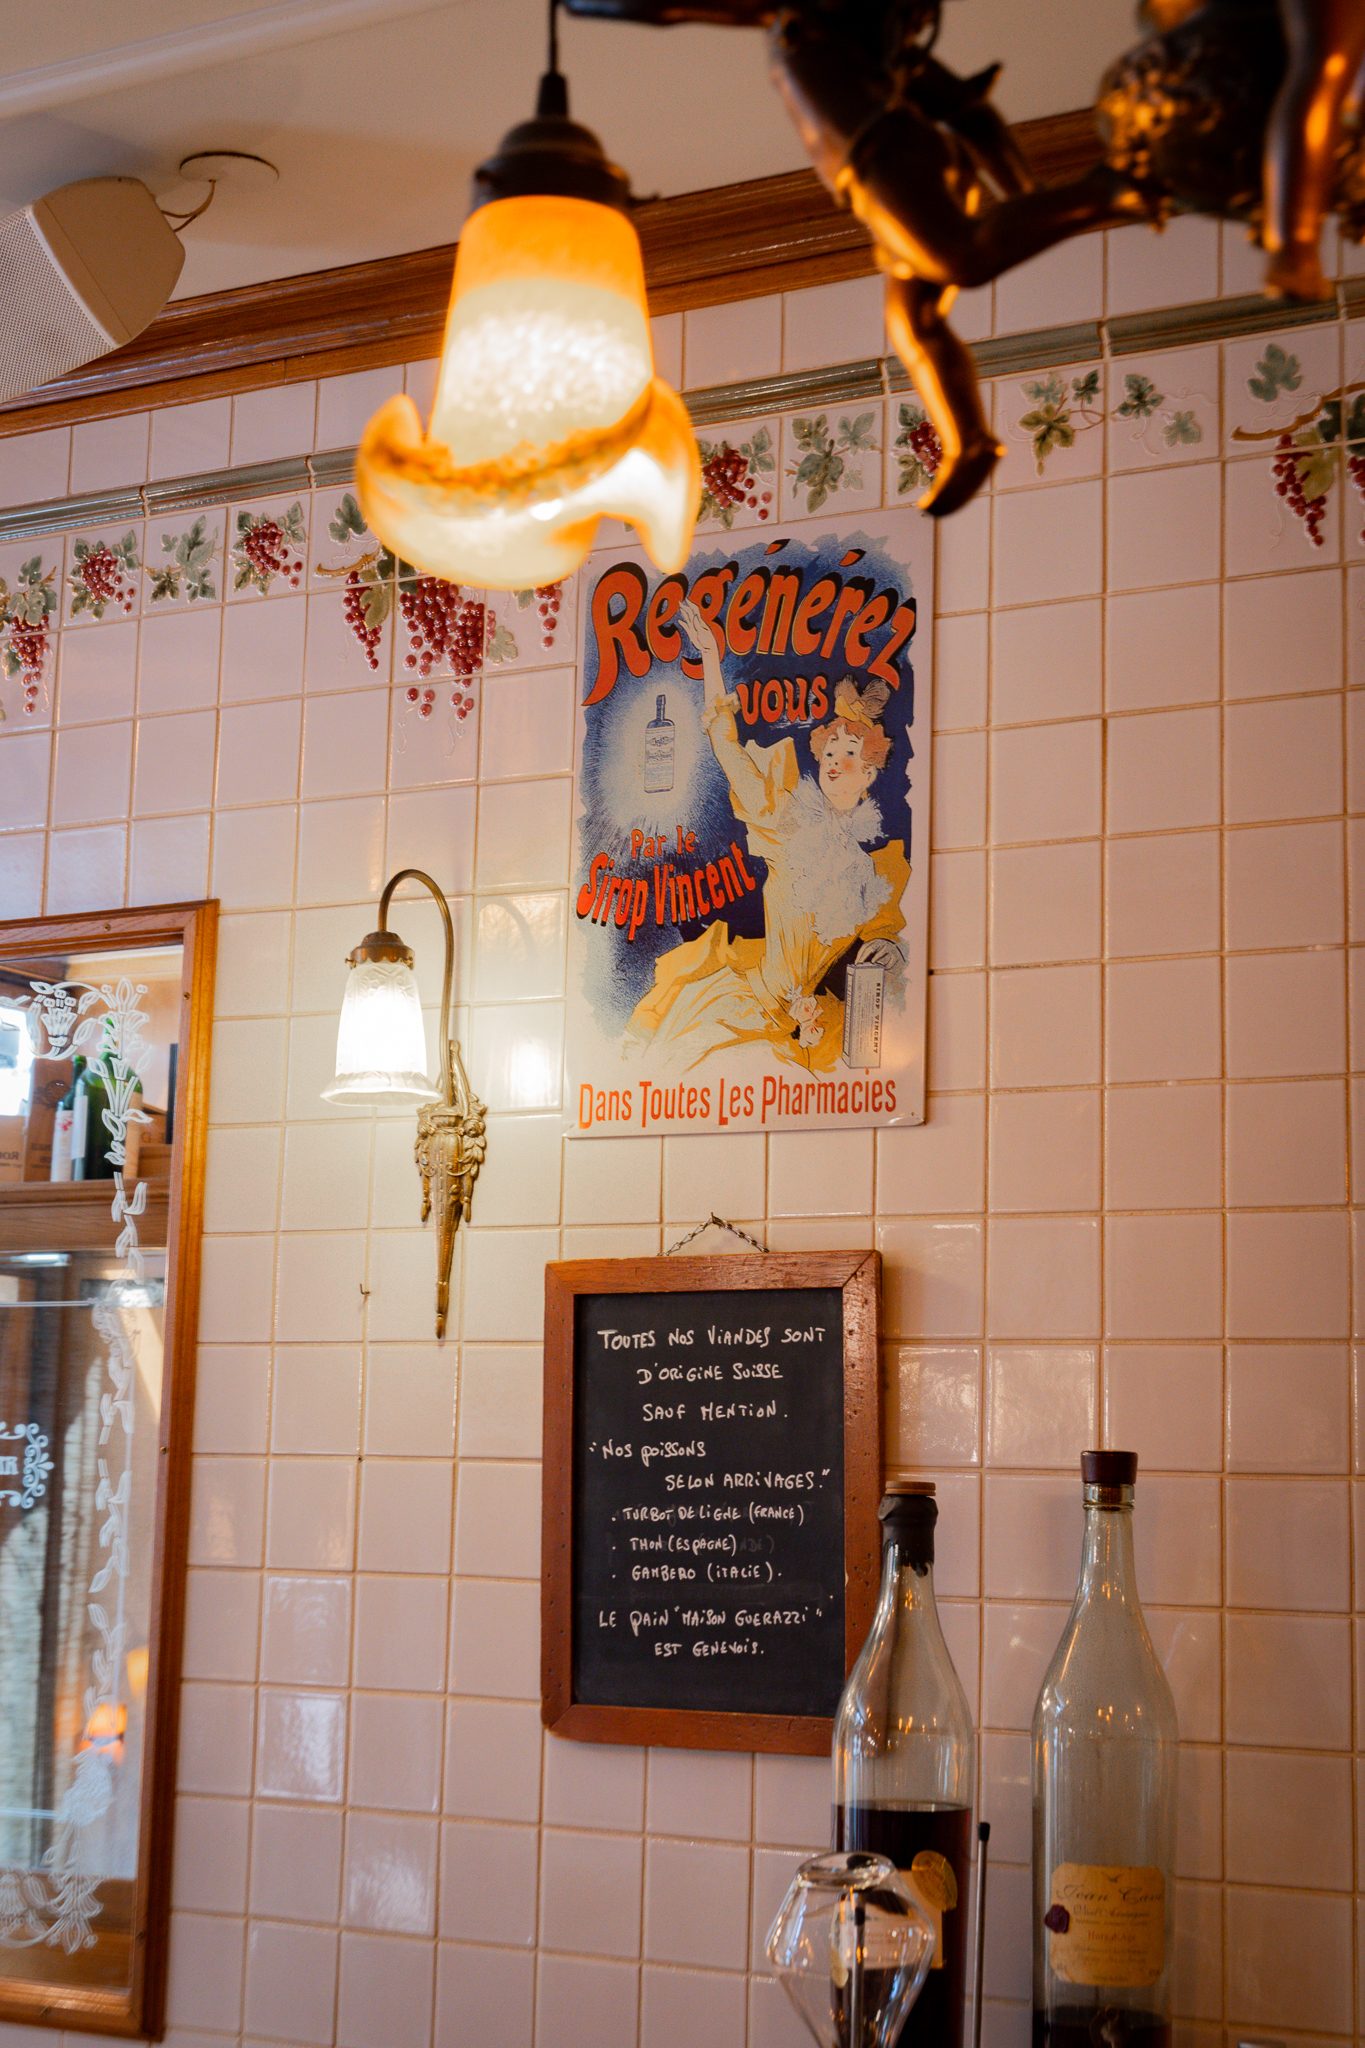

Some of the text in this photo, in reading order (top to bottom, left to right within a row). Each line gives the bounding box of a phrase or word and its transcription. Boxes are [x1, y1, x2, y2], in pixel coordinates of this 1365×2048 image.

[736, 676, 829, 726] vous
[631, 825, 696, 859] Par le
[576, 841, 756, 943] Sirop Vincent
[578, 1066, 897, 1129] Dans Toutes Les Pharmacies
[596, 1328, 656, 1351] TOUTES
[667, 1327, 695, 1347] NOS
[780, 1326, 826, 1344] SONT
[642, 1403, 686, 1422] SAUF
[664, 1473, 715, 1492] SELON
[622, 1506, 675, 1522] TURBOT
[677, 1505, 696, 1521] DE
[629, 1534, 663, 1551] THON
[631, 1564, 696, 1582] GAMBERO
[599, 1610, 617, 1628] LE
[654, 1642, 683, 1657] EST
